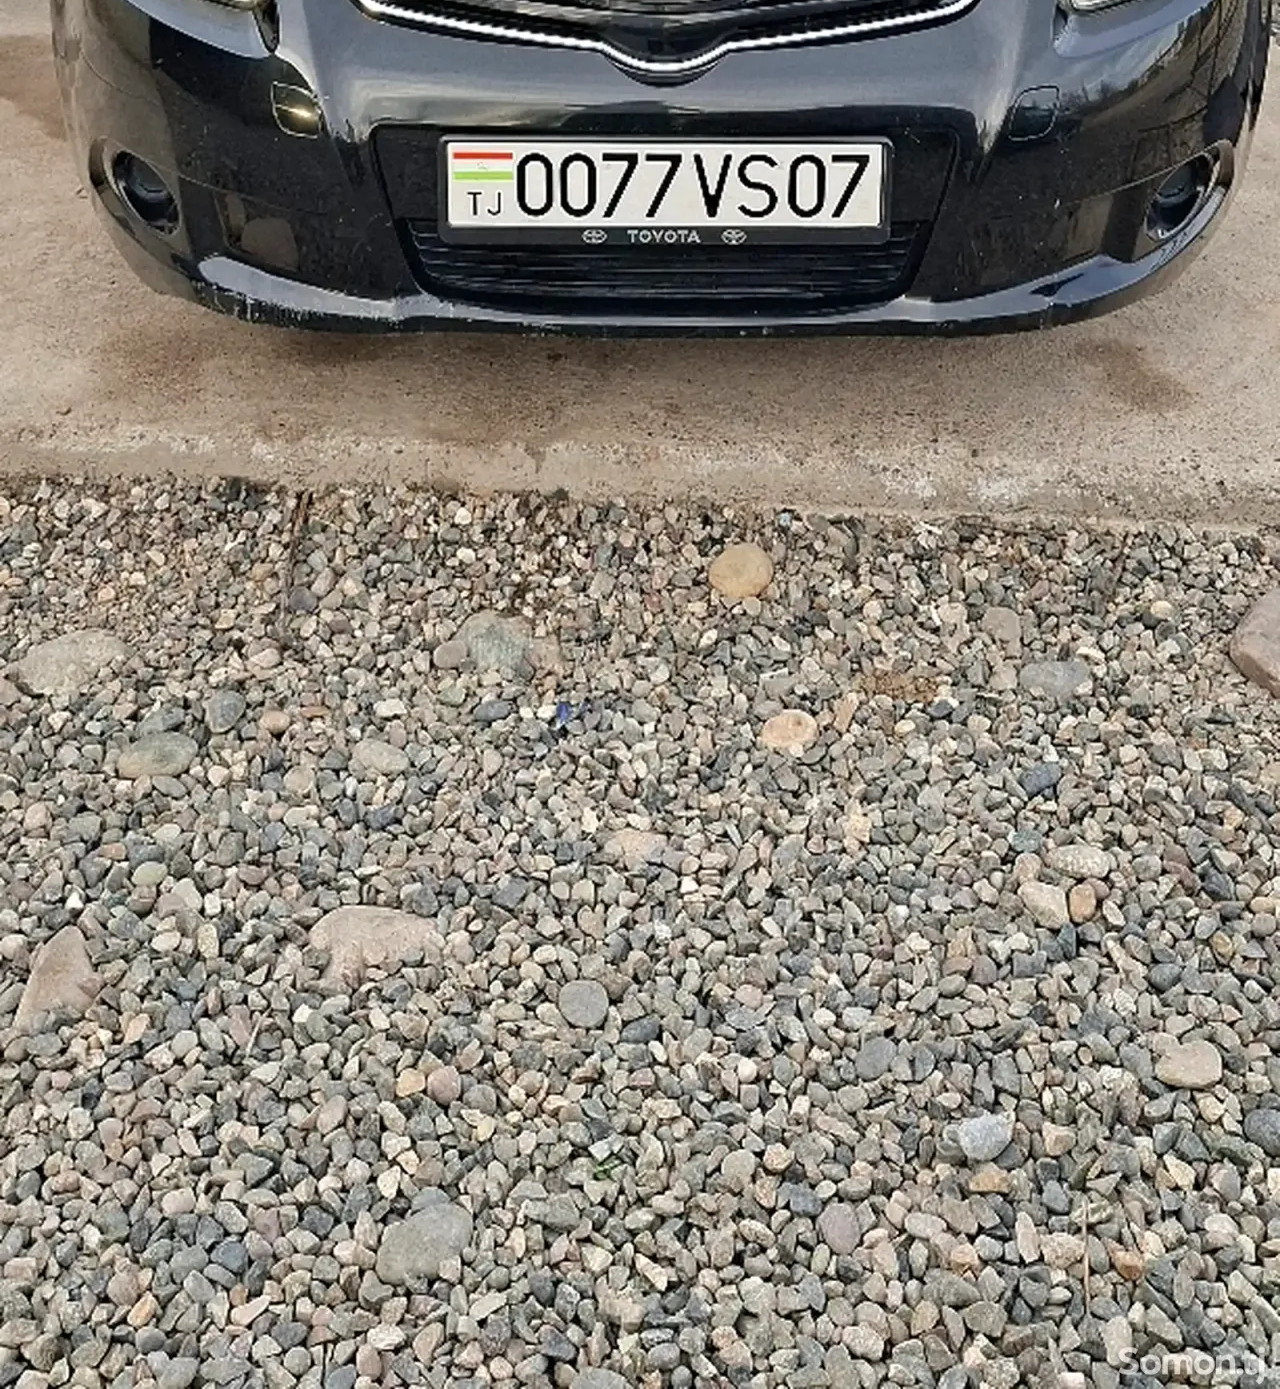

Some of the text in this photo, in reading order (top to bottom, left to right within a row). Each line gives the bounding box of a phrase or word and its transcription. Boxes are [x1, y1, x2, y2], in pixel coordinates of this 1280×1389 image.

[516, 153, 871, 218] 0077VS07
[466, 191, 502, 217] TJ
[627, 229, 700, 244] TOYOTA
